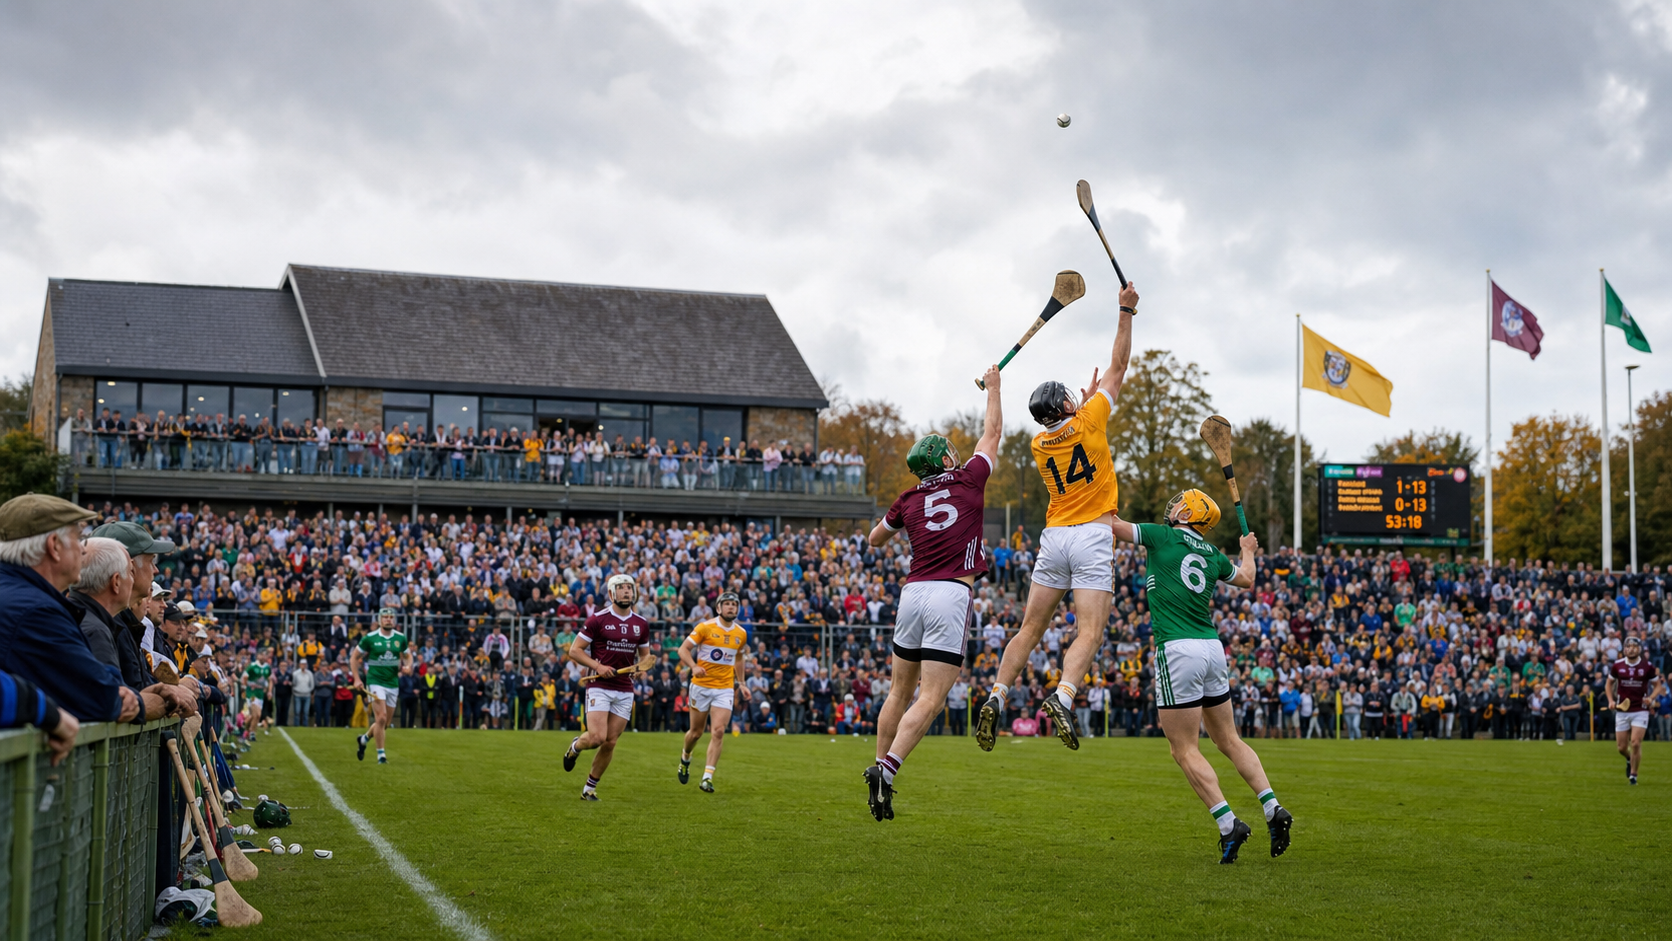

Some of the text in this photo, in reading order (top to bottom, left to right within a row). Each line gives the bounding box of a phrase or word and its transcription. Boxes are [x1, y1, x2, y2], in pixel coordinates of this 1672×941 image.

[1046, 443, 1097, 495] 14
[924, 489, 959, 532] 5
[1385, 514, 1422, 529] 53:18
[1180, 553, 1208, 594] 6
